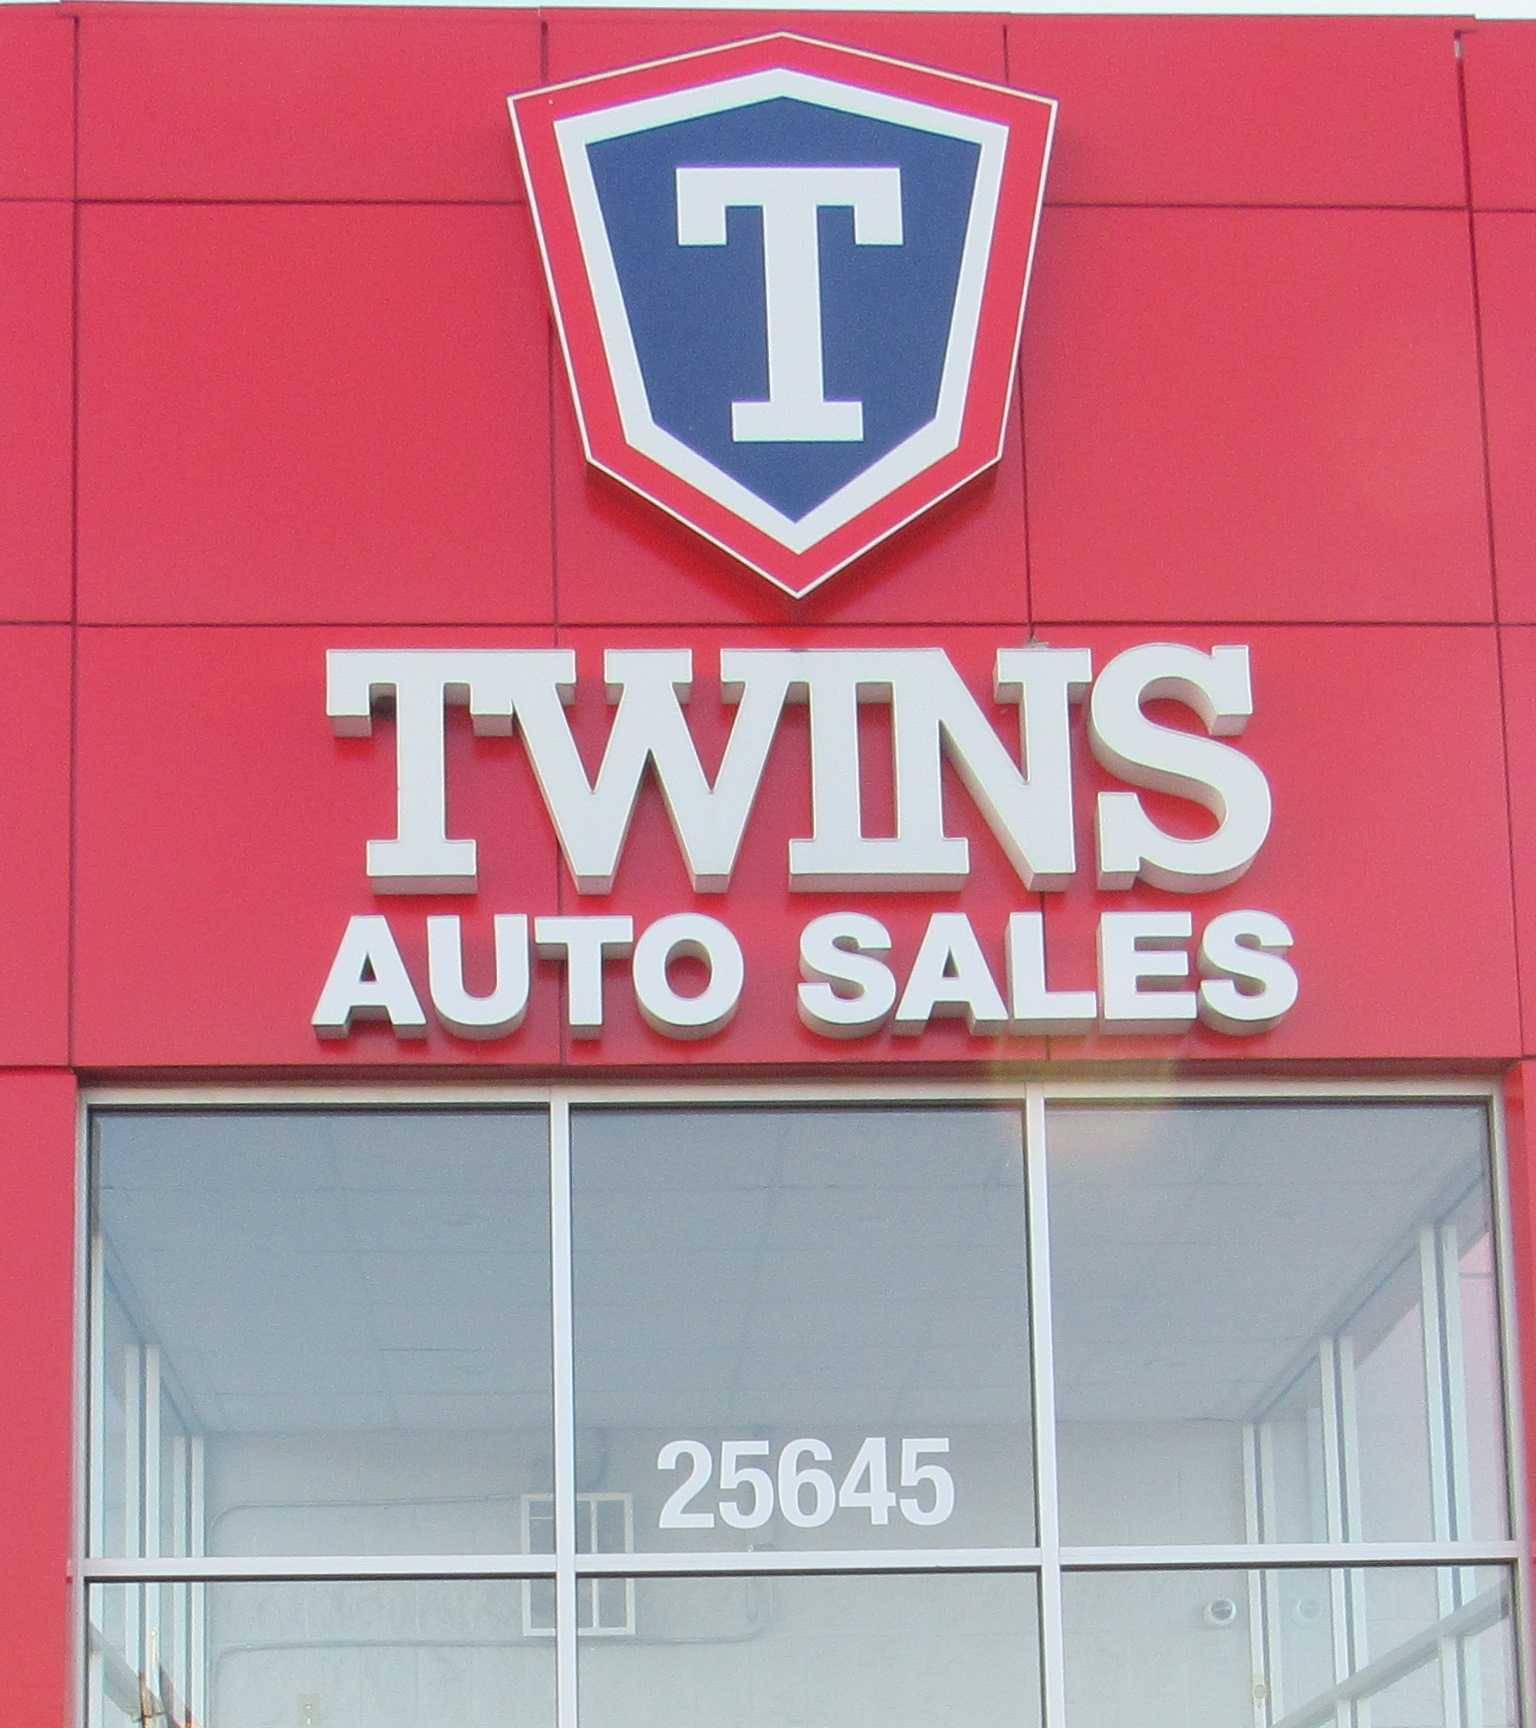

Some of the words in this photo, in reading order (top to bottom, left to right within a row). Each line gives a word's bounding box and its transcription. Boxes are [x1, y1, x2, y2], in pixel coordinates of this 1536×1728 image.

[675, 167, 903, 442] T
[326, 642, 1272, 893] TWINS
[311, 911, 744, 1040] AUTO
[796, 909, 1299, 1037] SALES
[656, 1436, 956, 1530] 25645
